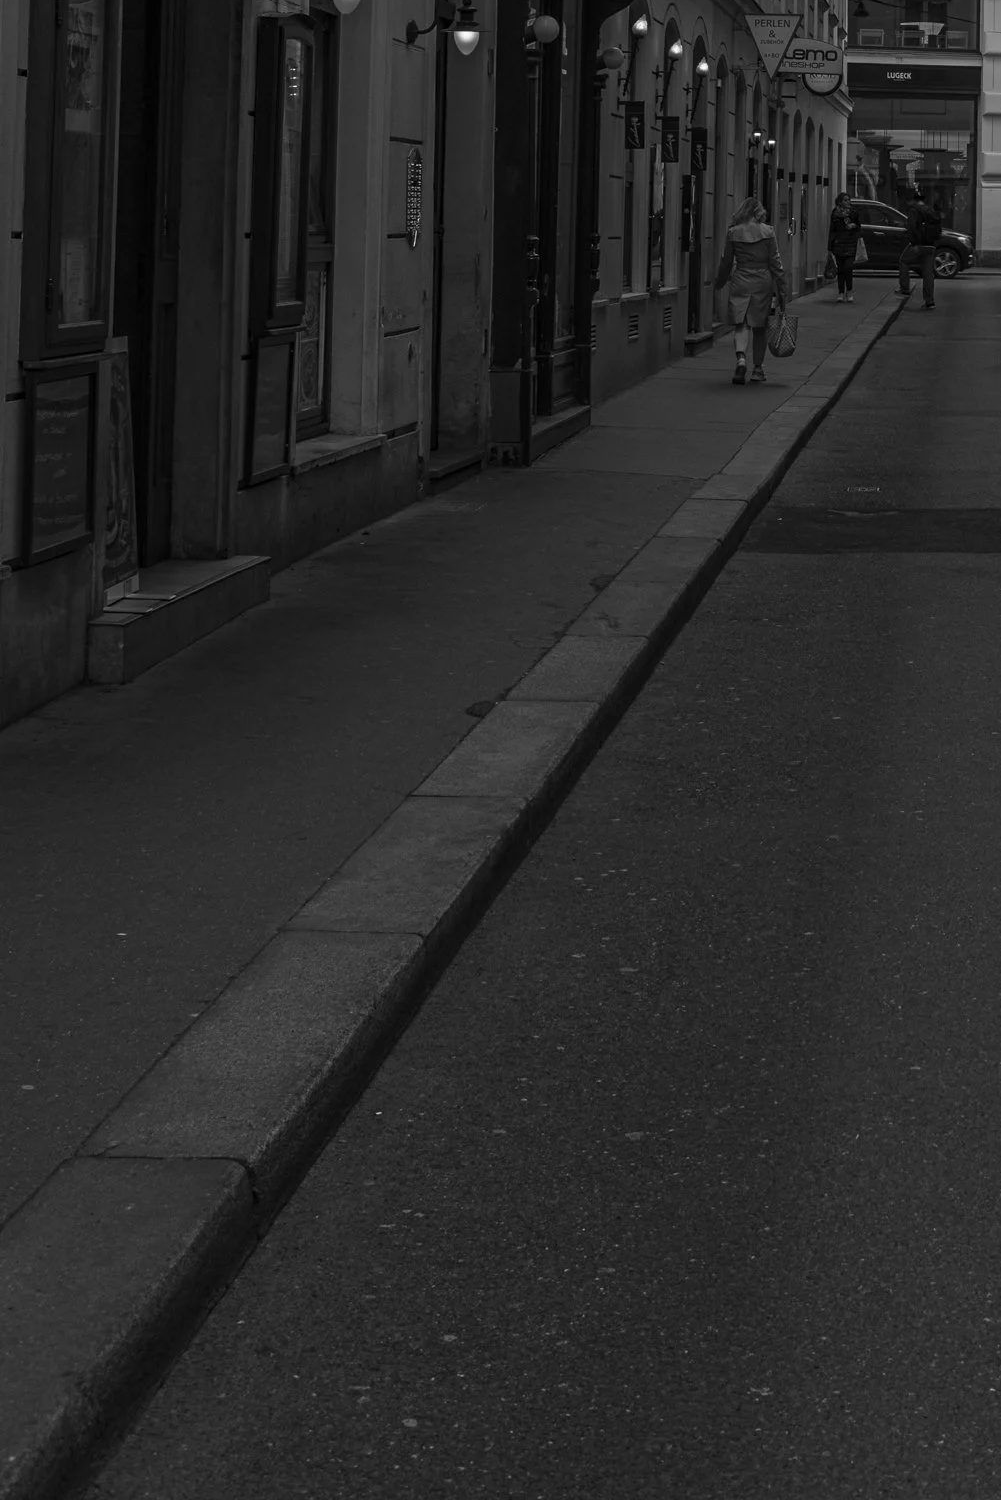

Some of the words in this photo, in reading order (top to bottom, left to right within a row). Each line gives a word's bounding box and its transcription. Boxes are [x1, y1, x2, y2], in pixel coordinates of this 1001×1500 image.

[754, 19, 791, 28] PERLEN
[768, 29, 776, 38] &
[887, 71, 912, 80] LUGECK
